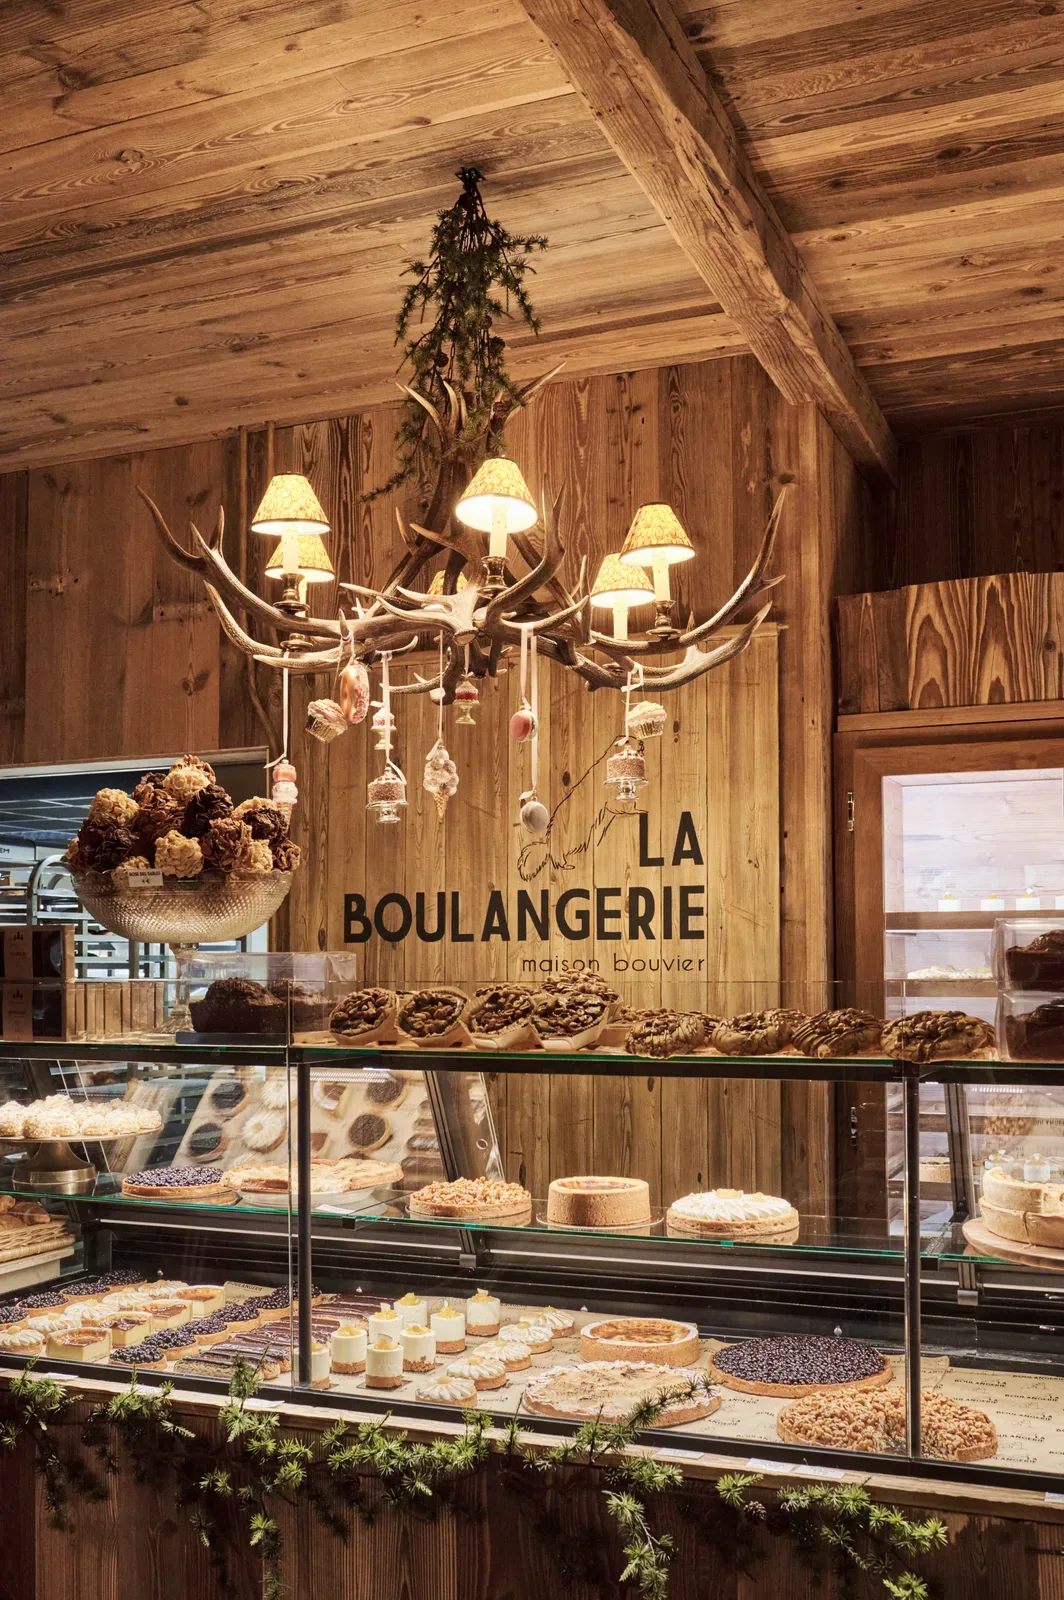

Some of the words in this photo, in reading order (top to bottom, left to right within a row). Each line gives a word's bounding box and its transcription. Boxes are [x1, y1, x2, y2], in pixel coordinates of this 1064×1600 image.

[639, 811, 704, 867] LA
[344, 886, 704, 943] BOULANGERIE
[522, 955, 599, 972] maison
[613, 953, 704, 972] bouvier
